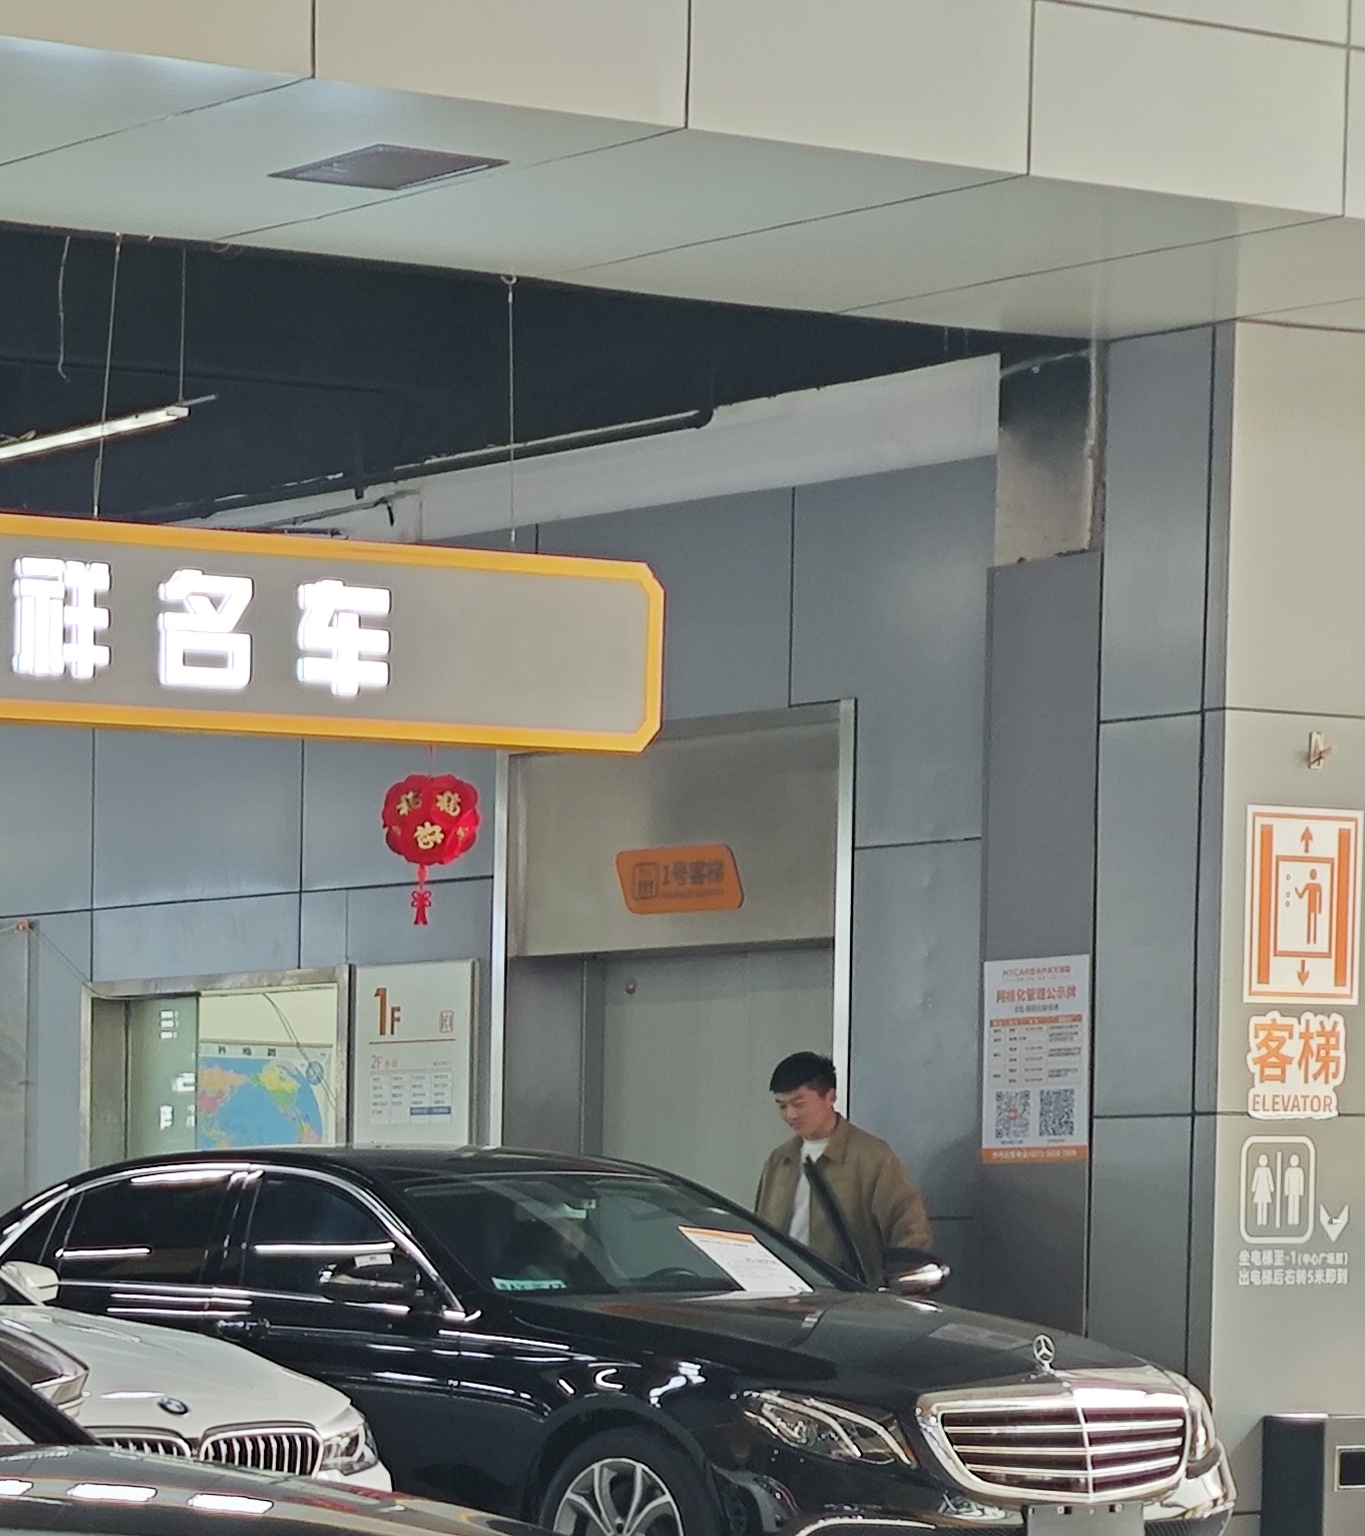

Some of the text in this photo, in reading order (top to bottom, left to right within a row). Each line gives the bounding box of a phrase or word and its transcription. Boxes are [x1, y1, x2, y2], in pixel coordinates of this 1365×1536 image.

[373, 986, 401, 1036] 1F
[1254, 1018, 1342, 1085] 客梯
[1253, 1094, 1333, 1112] ELEVATOR
